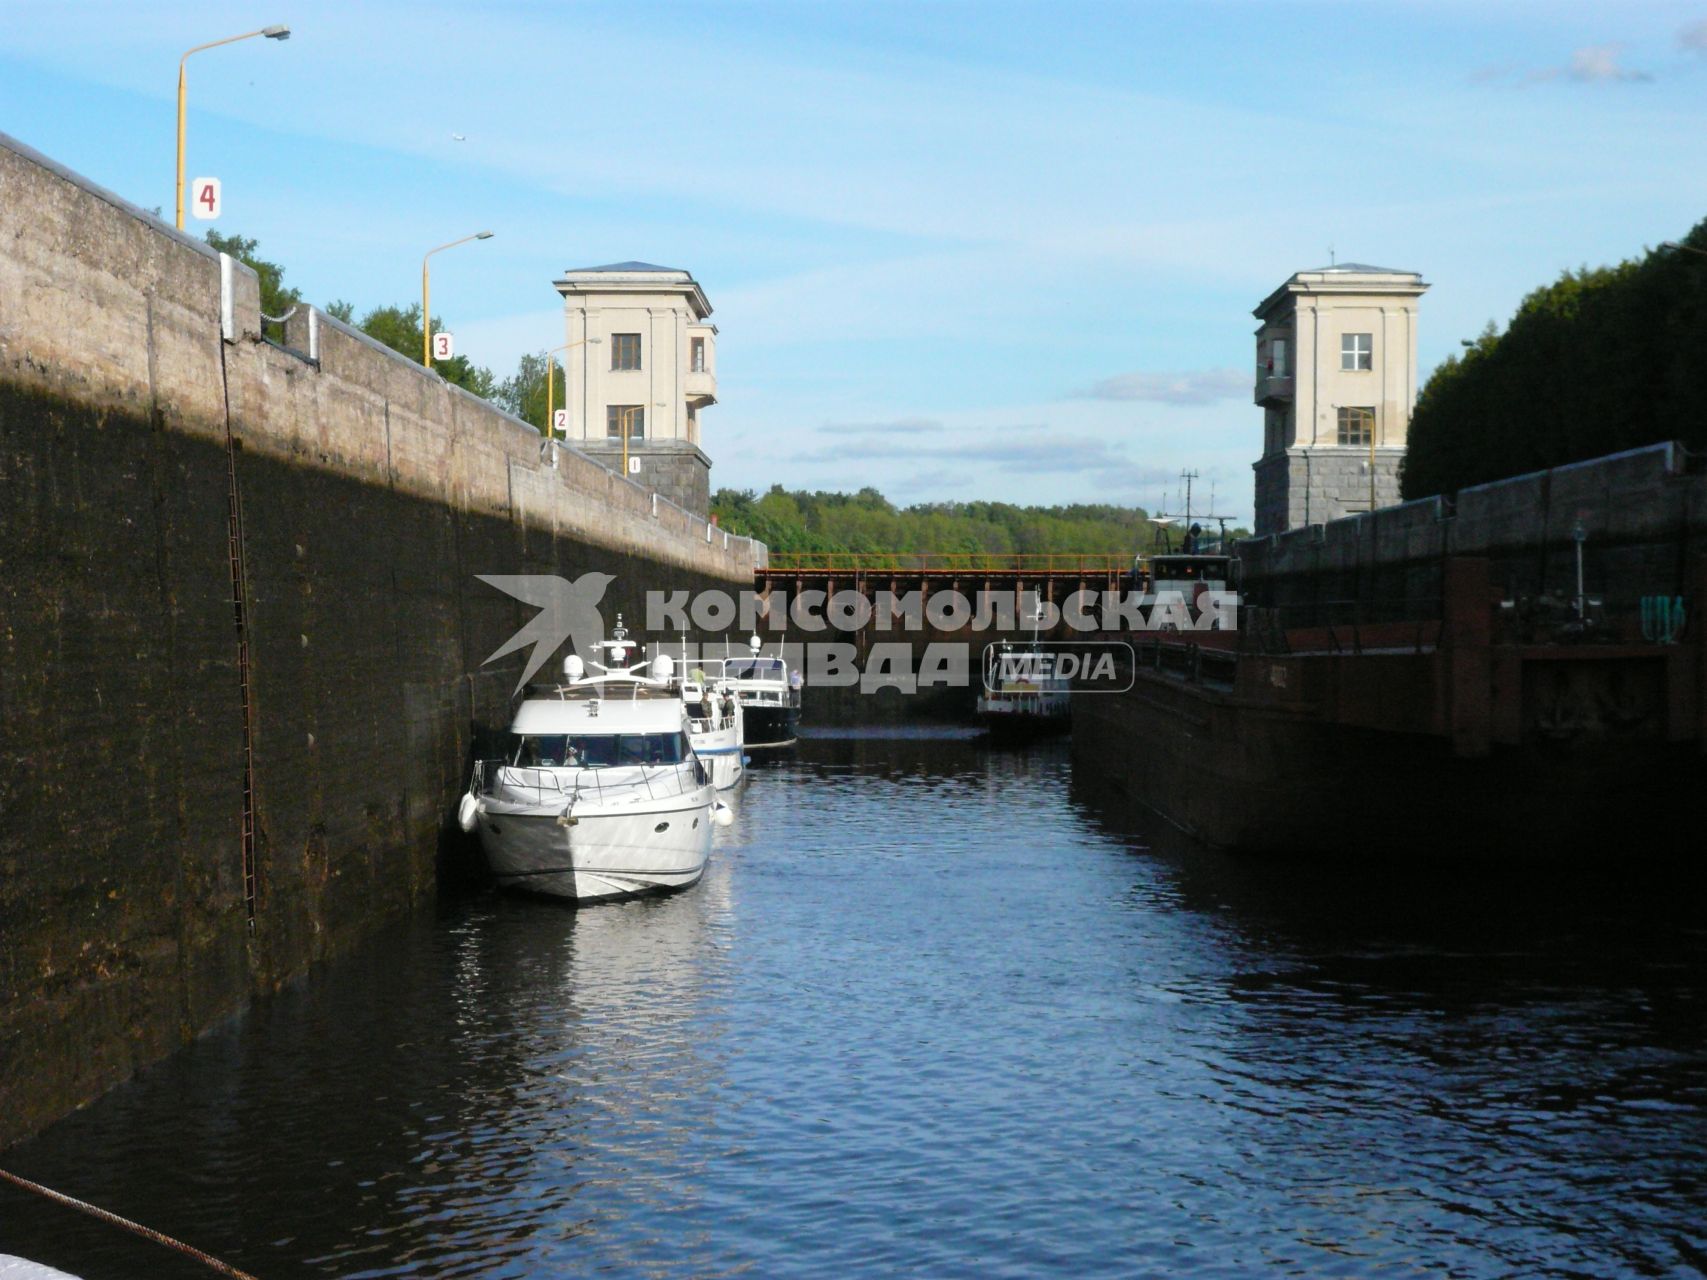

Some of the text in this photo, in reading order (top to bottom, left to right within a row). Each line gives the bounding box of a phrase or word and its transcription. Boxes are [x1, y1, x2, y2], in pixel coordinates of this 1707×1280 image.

[199, 184, 216, 212] 4
[438, 337, 449, 356] 3
[557, 412, 567, 427] 2
